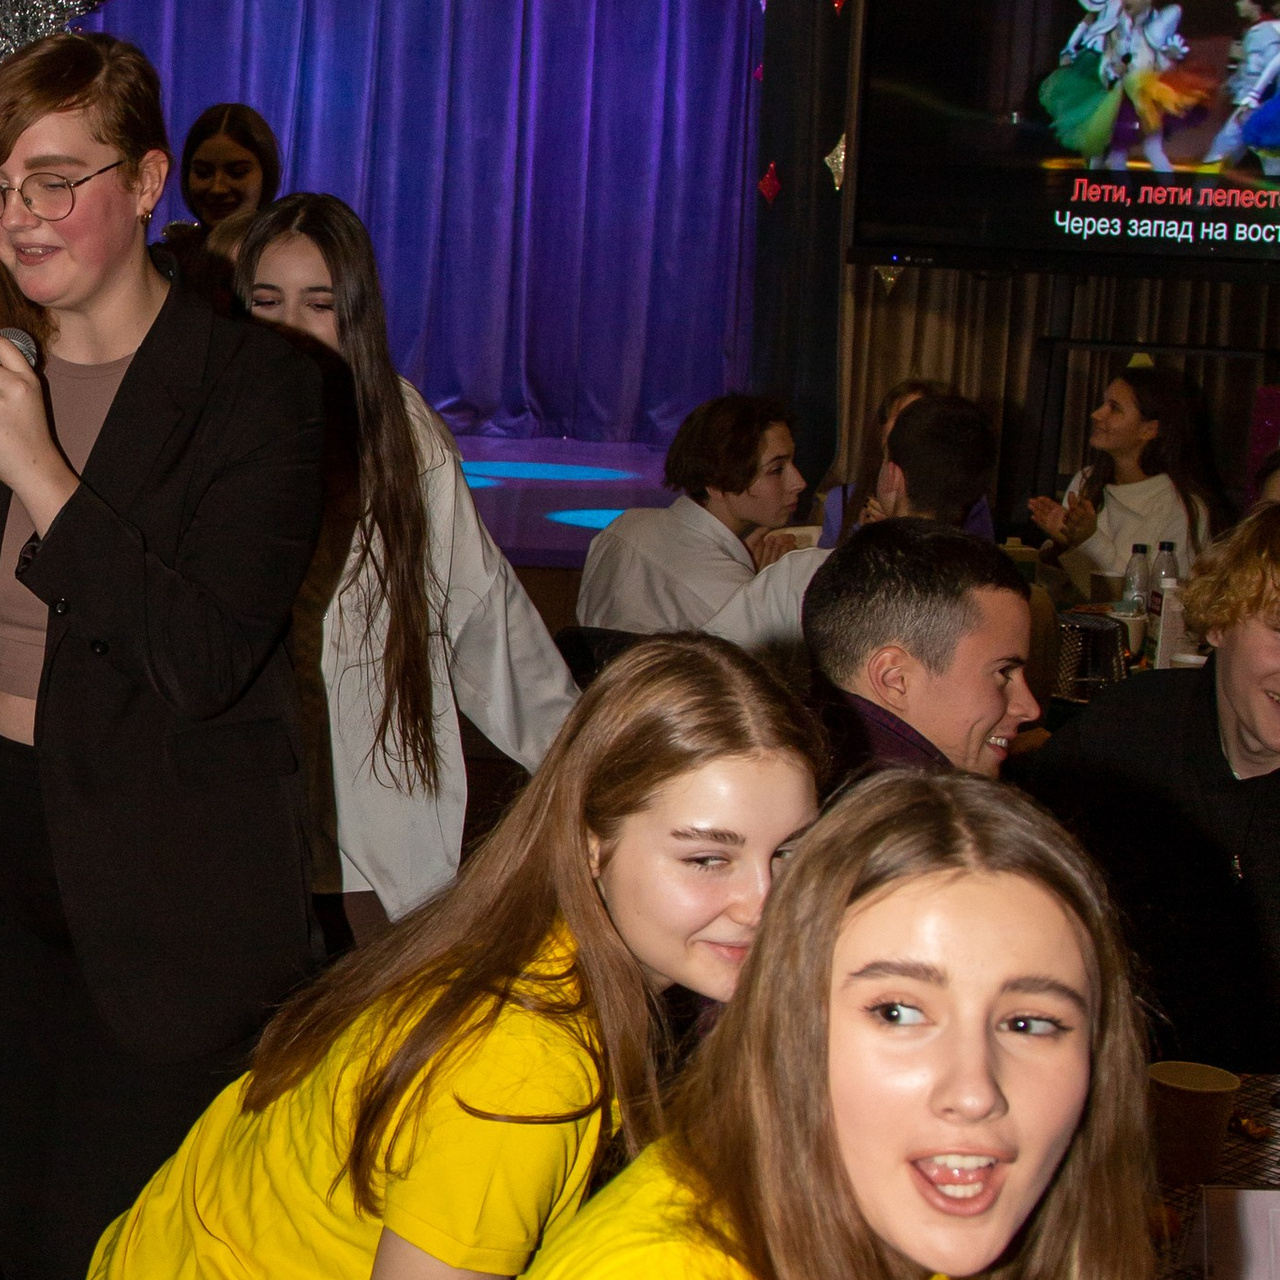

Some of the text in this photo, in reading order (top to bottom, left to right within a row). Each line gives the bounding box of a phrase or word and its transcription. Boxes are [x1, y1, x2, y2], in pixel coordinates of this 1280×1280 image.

[1070, 178, 1280, 209] Лети, лети лепест
[1055, 210, 1121, 240] Через
[1127, 218, 1193, 243] запад
[1200, 222, 1227, 240] на
